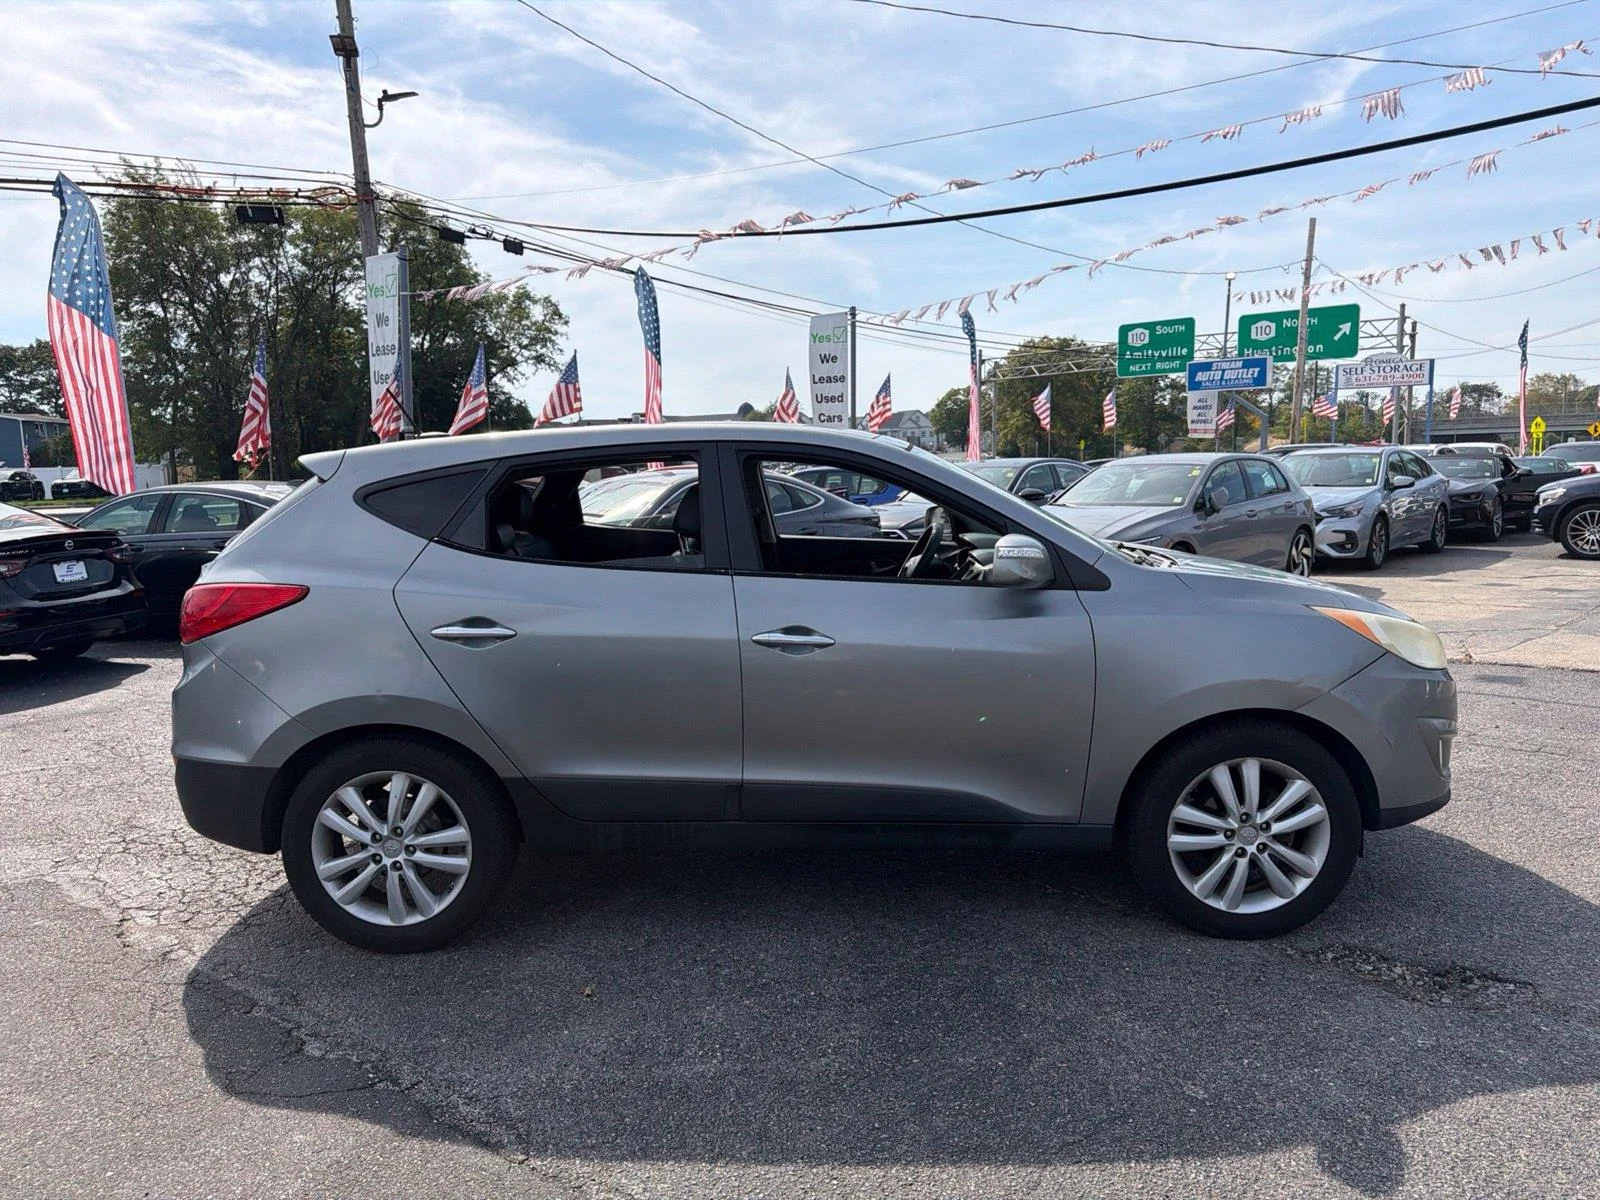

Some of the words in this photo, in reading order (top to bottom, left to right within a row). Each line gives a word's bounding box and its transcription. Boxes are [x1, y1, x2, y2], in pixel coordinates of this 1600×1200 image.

[368, 283, 385, 298] Yes
[375, 312, 390, 328] We
[1131, 332, 1146, 343] 110
[1155, 324, 1186, 335] SOUTH
[1255, 324, 1272, 337] 110
[1282, 317, 1318, 328] NOTH
[811, 332, 832, 344] Yes
[371, 342, 396, 357] Lease
[1124, 346, 1188, 361] Amityville
[1244, 344, 1323, 357] Huntingon
[819, 353, 838, 365] We
[1211, 360, 1243, 370] STREAM
[1374, 357, 1404, 365] OMEGA
[1129, 362, 1152, 372] NEXT
[1155, 360, 1181, 370] RIGHT
[1342, 366, 1367, 376] SELF
[1369, 363, 1426, 375] STORAGE
[374, 369, 393, 385] Use
[812, 374, 846, 385] Lease
[1195, 370, 1222, 382] AUTO
[1223, 368, 1261, 380] OUTLET
[1355, 372, 1425, 383] 631-789-4900
[816, 392, 844, 404] Used
[818, 412, 843, 423] Cars
